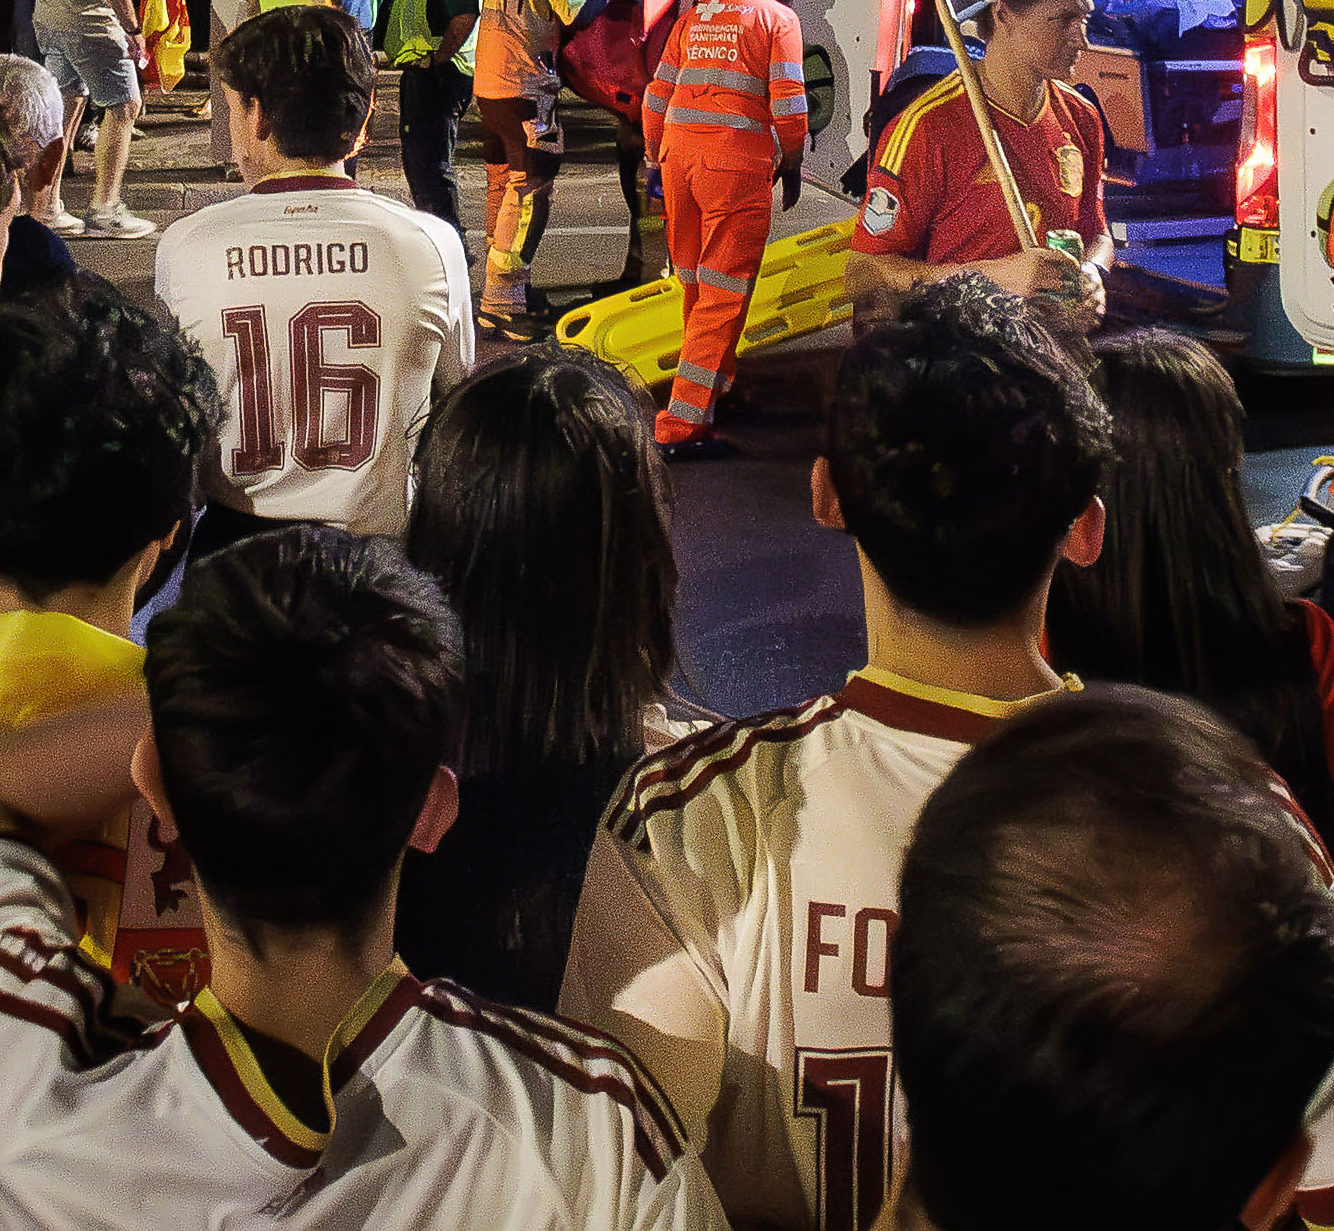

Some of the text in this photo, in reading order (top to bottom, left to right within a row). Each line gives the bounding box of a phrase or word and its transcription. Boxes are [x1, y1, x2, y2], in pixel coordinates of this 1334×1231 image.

[686, 44, 739, 62] TÉCNICO
[226, 242, 369, 280] RODRIGO
[221, 300, 382, 476] 16
